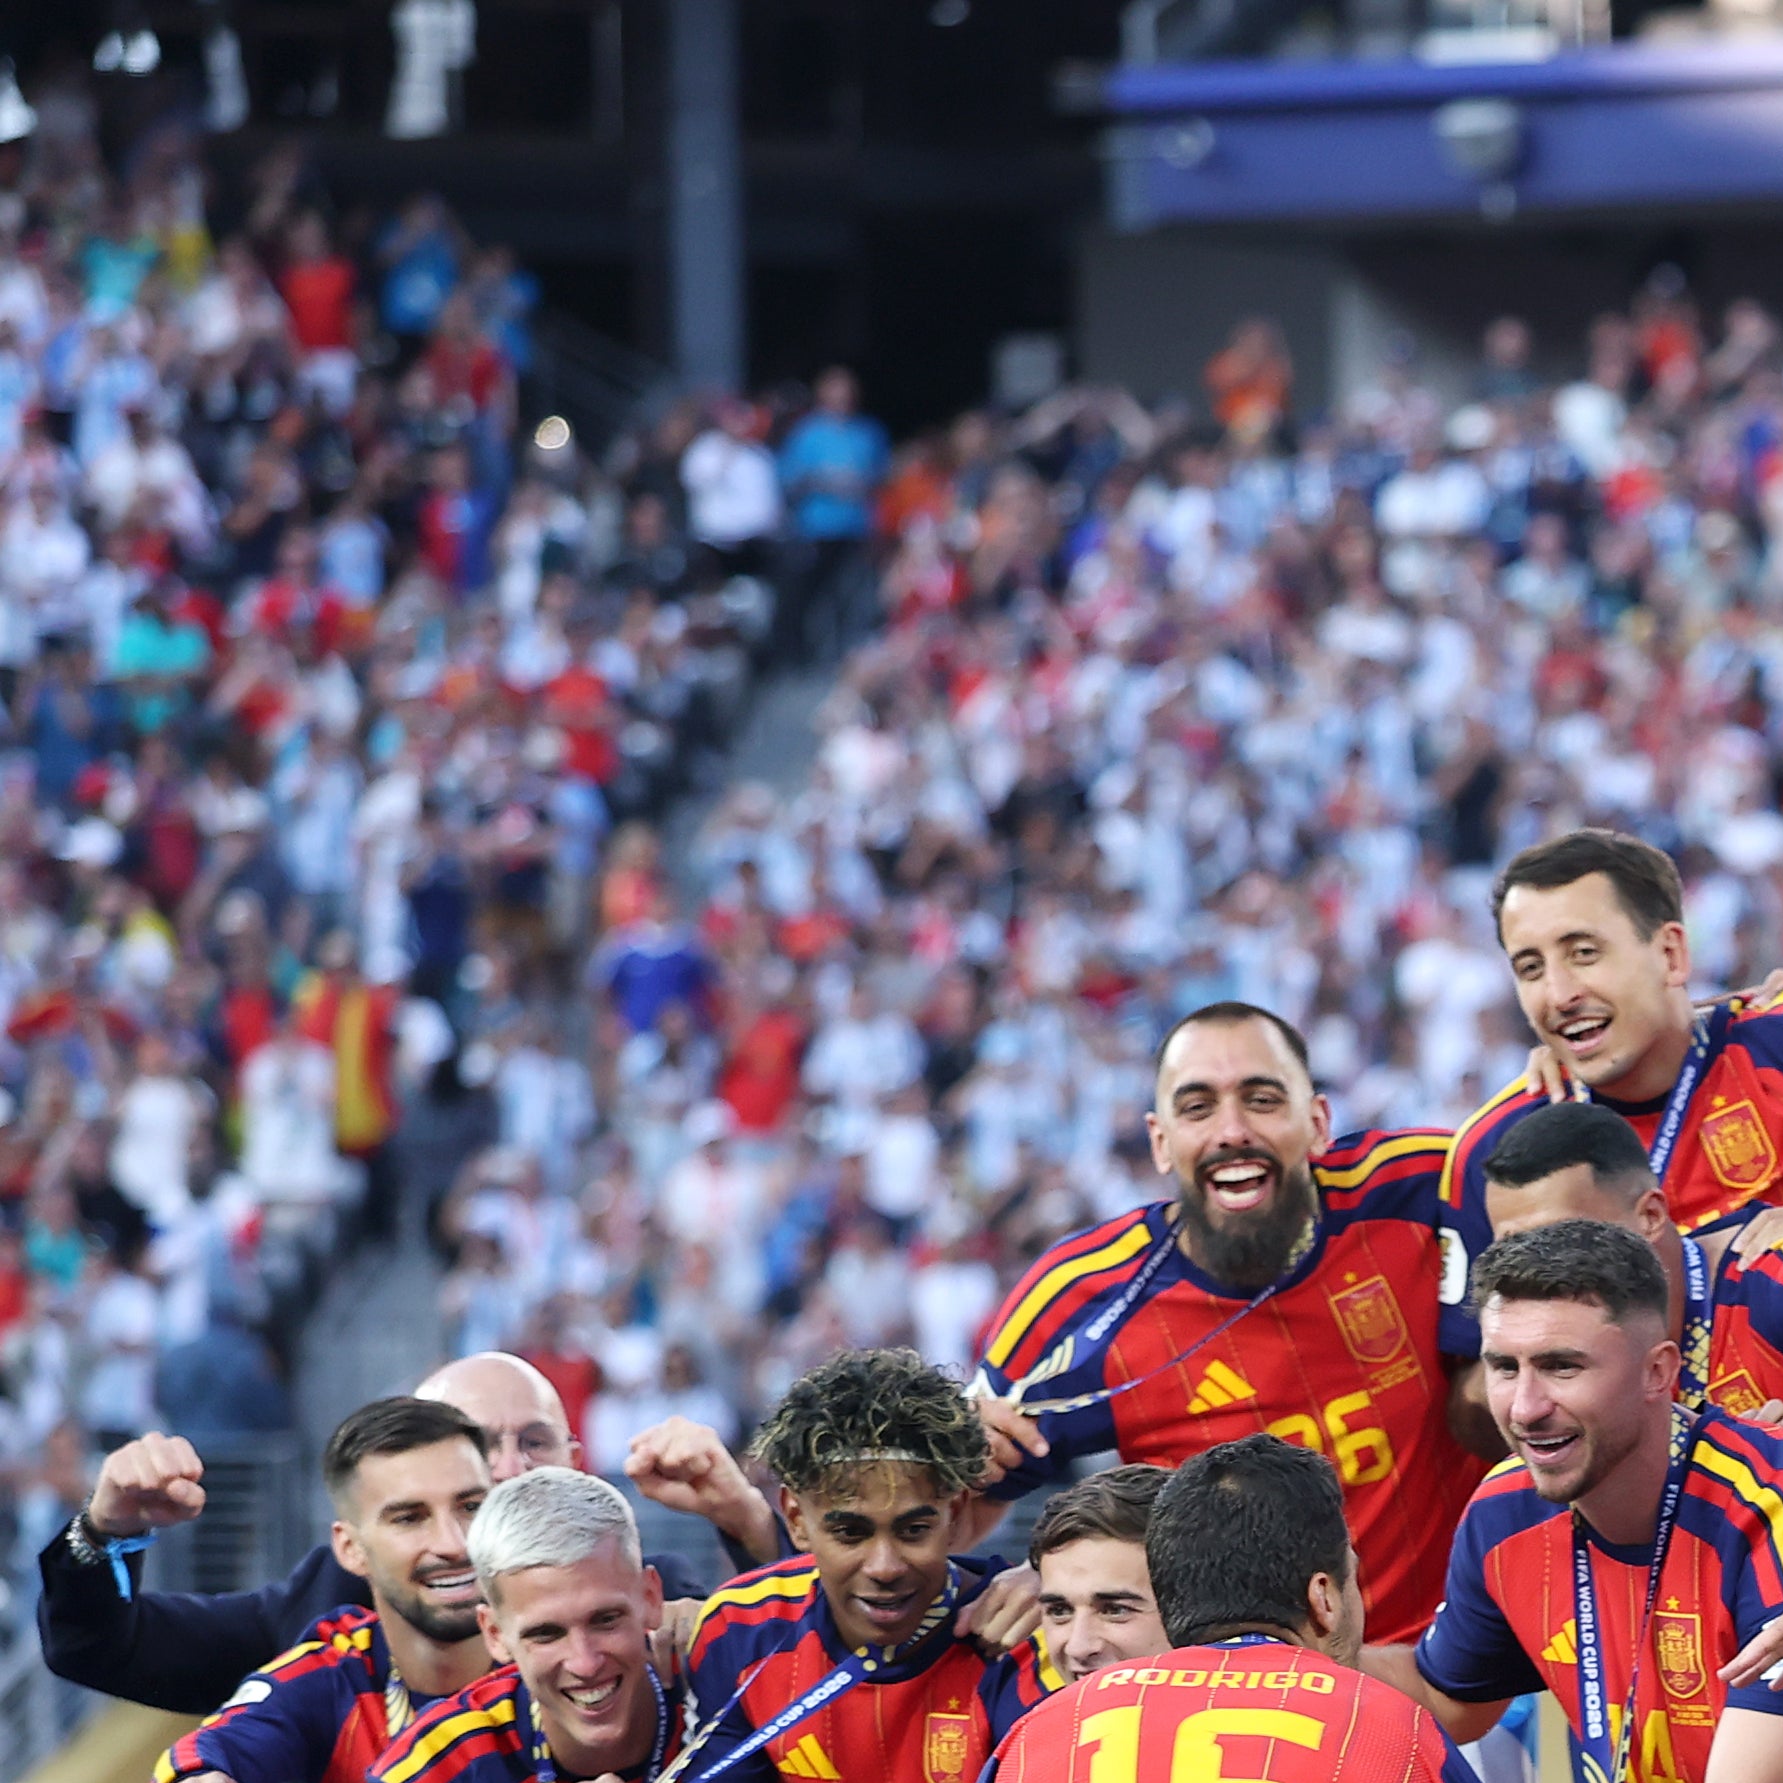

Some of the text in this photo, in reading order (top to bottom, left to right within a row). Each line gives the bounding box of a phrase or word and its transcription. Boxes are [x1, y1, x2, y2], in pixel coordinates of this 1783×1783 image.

[1661, 1108, 1681, 1138] CUP
[1688, 1266, 1706, 1301] FIFA
[1661, 1483, 1680, 1518] FIFA
[1651, 1518, 1671, 1577] WORLD
[1576, 1549, 1604, 1740] FIFA WORLD CUP 2026
[1097, 1668, 1336, 1695] RODRIGO
[729, 1724, 781, 1760] WORLD
[776, 1703, 806, 1728] CUP
[802, 1669, 855, 1709] 2026
